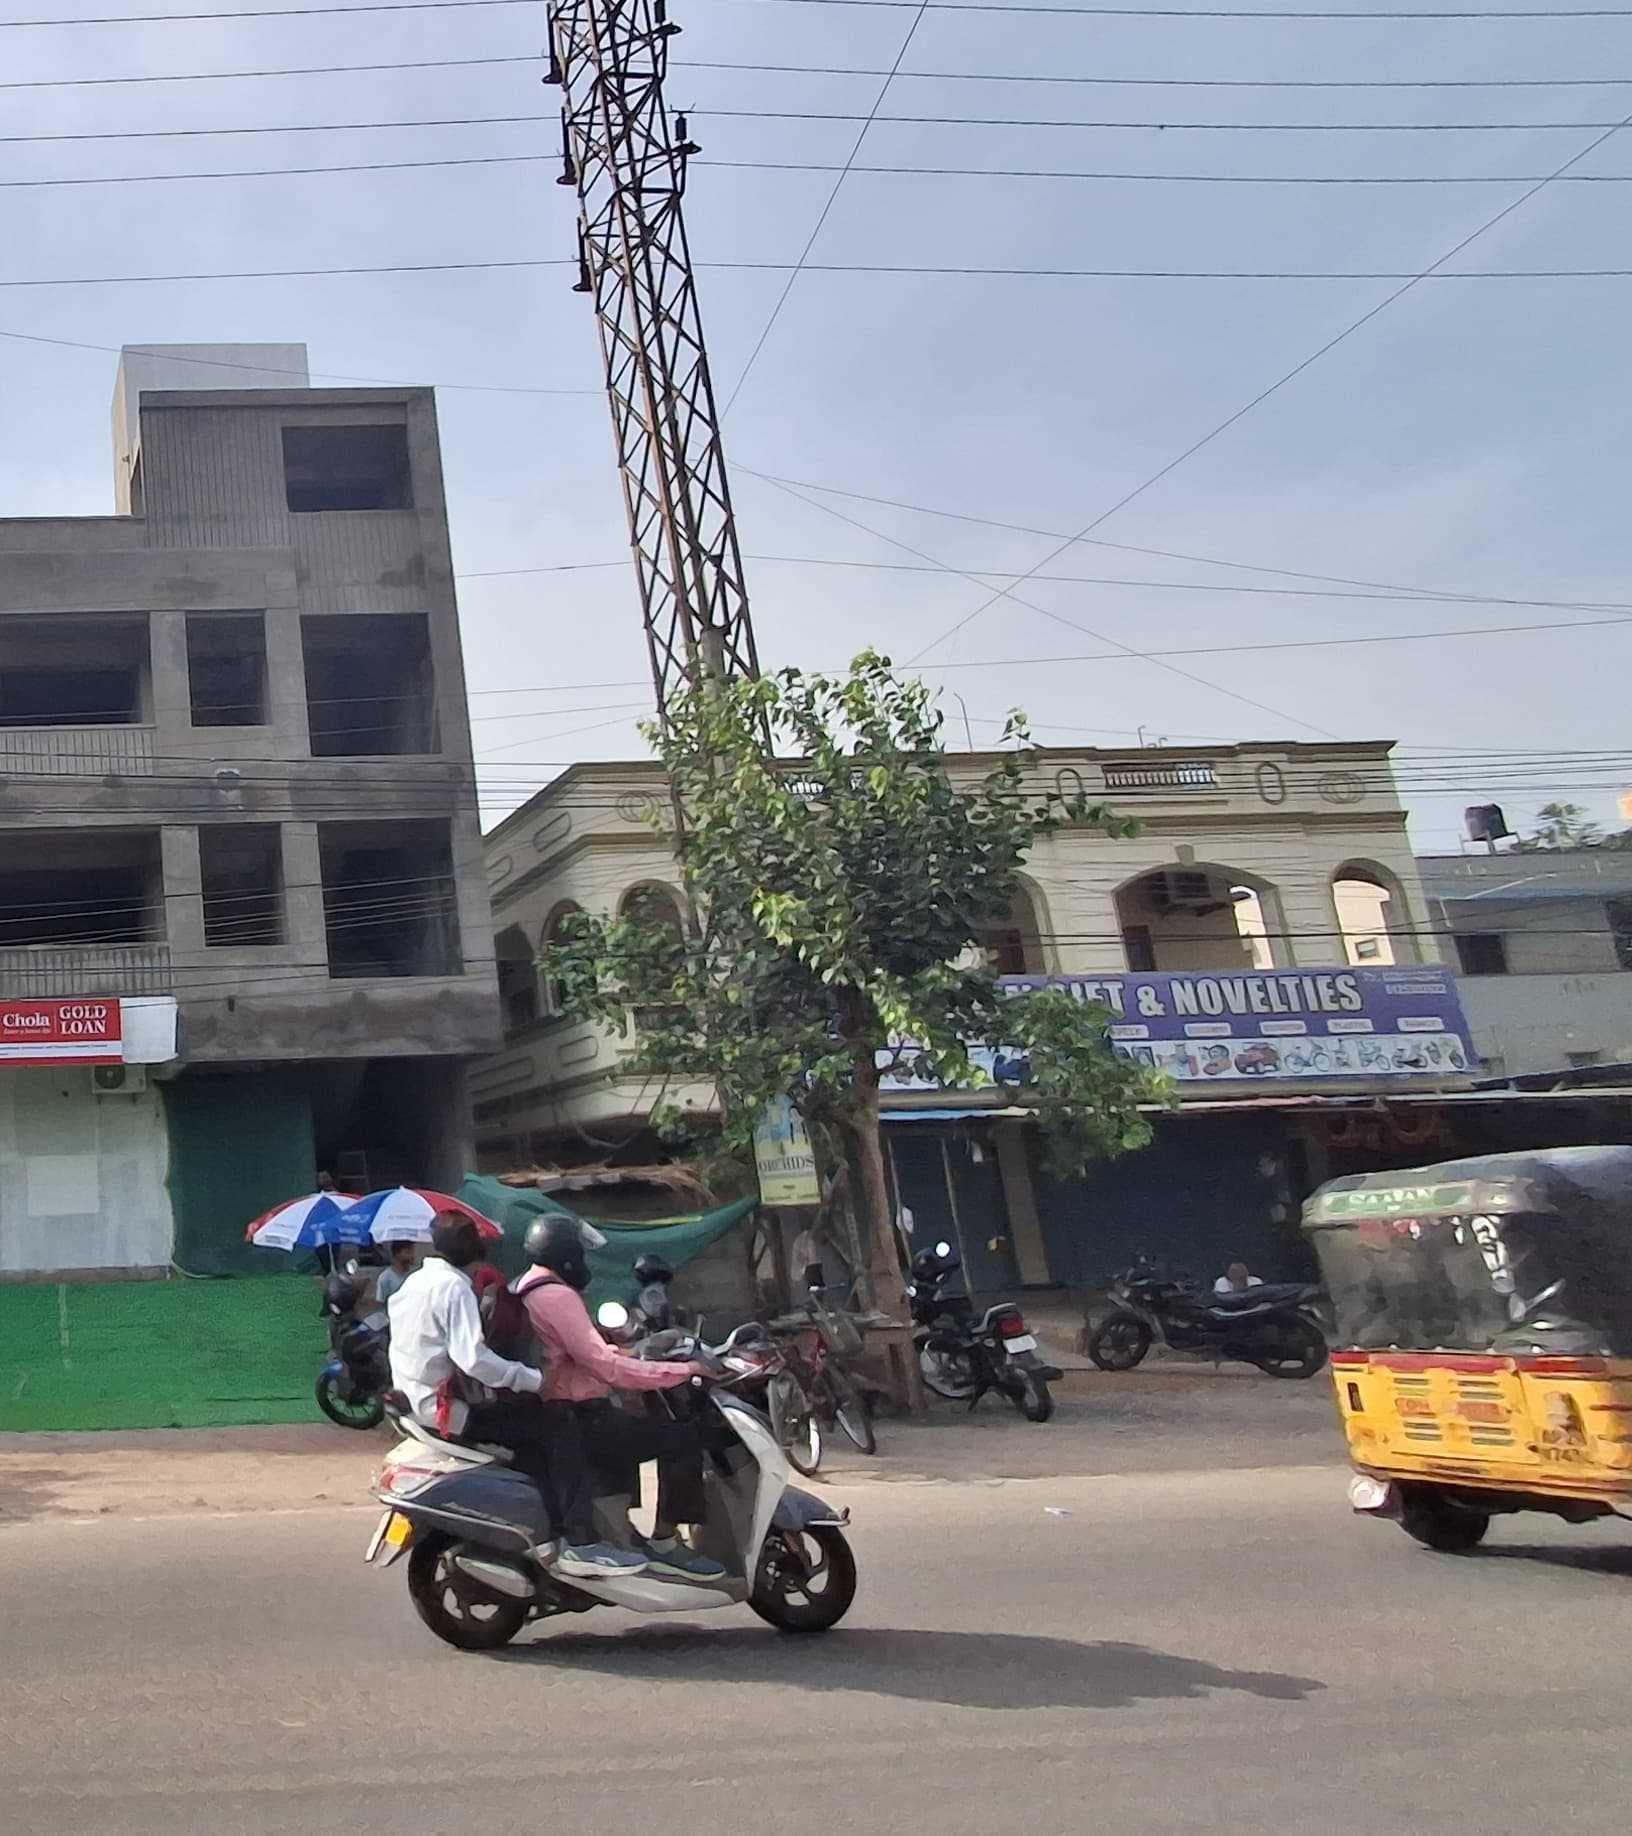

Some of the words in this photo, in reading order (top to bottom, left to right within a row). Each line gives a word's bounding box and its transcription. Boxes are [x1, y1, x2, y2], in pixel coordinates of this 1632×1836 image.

[1136, 985, 1166, 1017] &
[1170, 974, 1363, 1016] NOVELTIES
[59, 1005, 107, 1019] GOLD
[2, 1012, 50, 1027] Chola
[60, 1020, 106, 1034] LOAN
